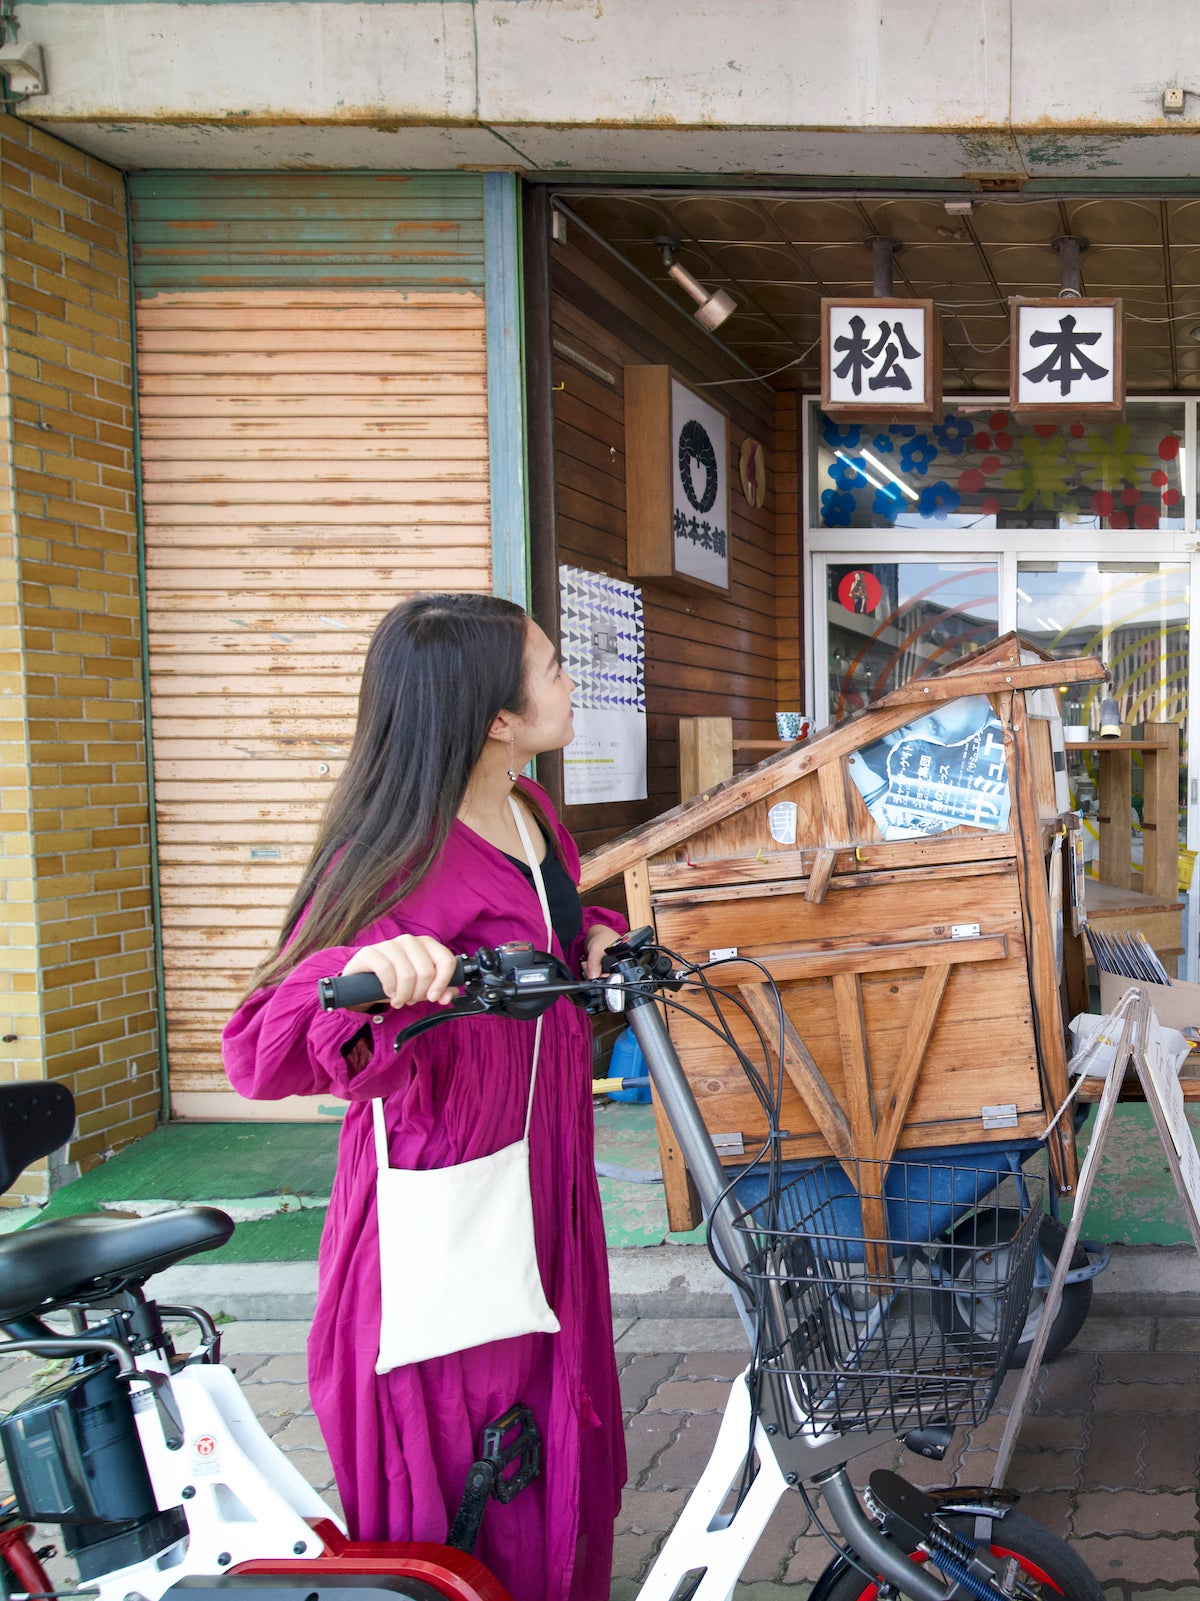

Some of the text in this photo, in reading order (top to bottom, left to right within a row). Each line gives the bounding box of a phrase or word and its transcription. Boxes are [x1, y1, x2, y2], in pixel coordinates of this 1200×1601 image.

[833, 315, 921, 396] 松
[1022, 315, 1109, 397] 本
[674, 508, 726, 558] 松本茶舗
